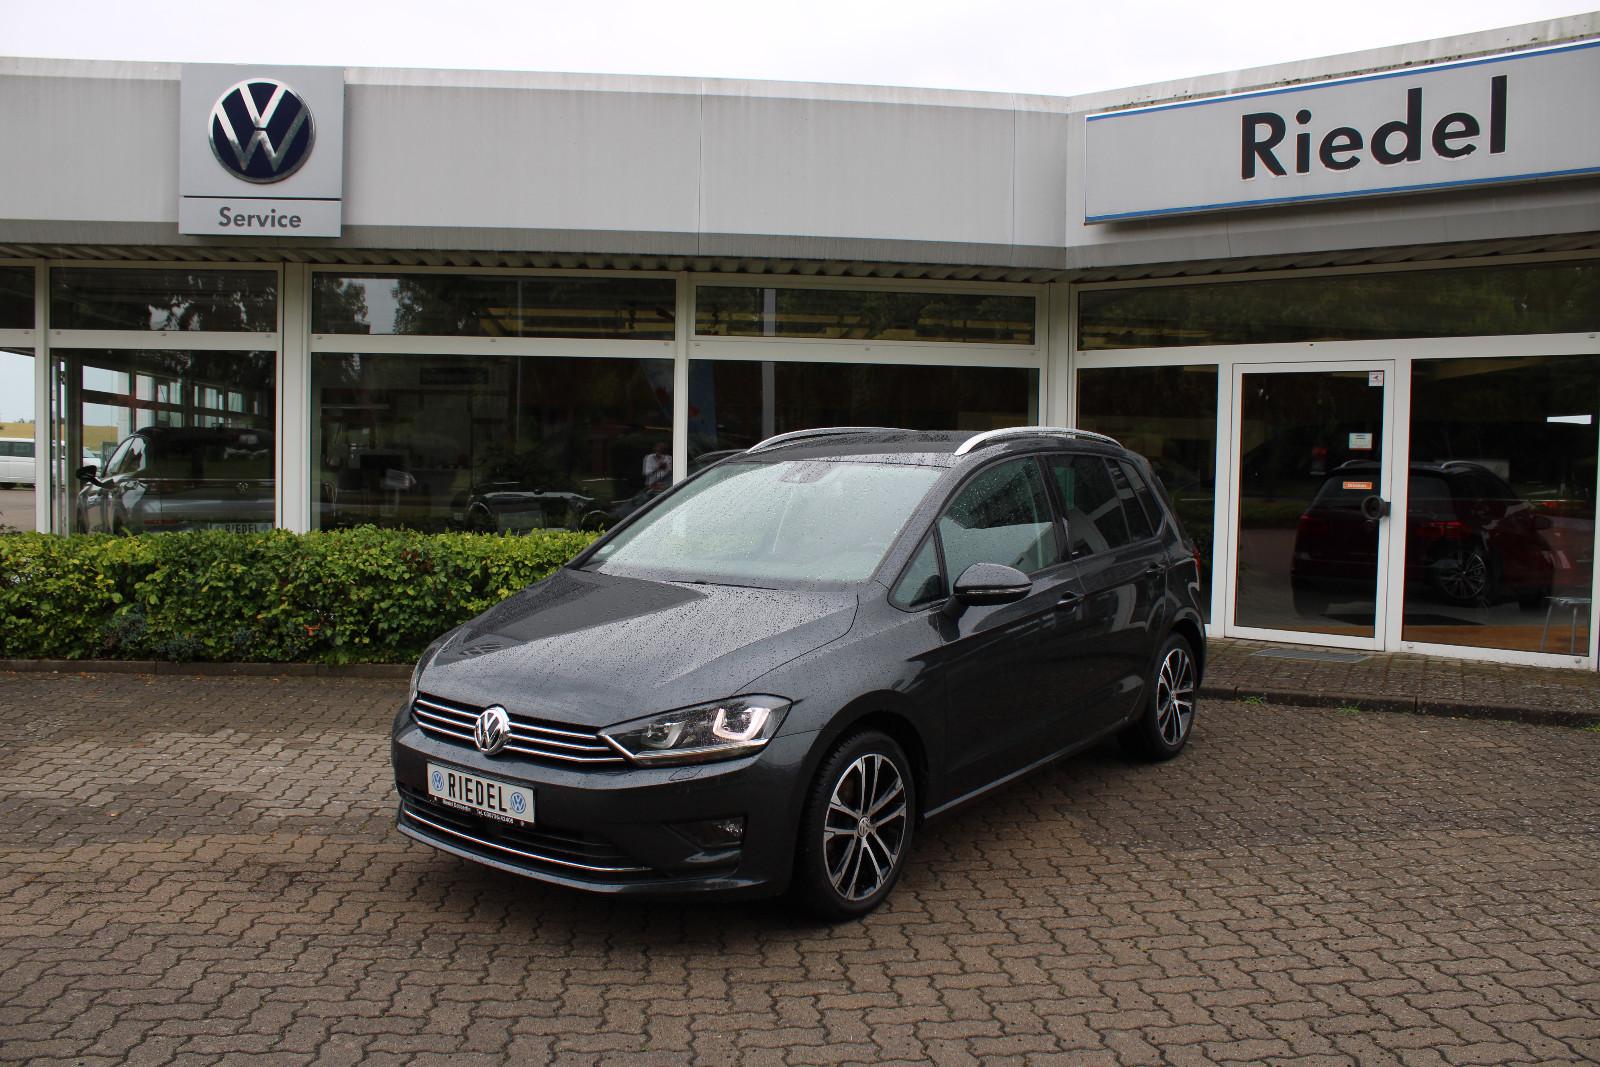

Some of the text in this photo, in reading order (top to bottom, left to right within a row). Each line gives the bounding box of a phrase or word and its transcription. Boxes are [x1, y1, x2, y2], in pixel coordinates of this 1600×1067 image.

[209, 78, 316, 184] VW
[1241, 75, 1507, 180] Riedel
[218, 206, 302, 228] Service
[475, 707, 507, 754] VW
[448, 773, 507, 812] RIEDEL
[510, 792, 526, 814] VW
